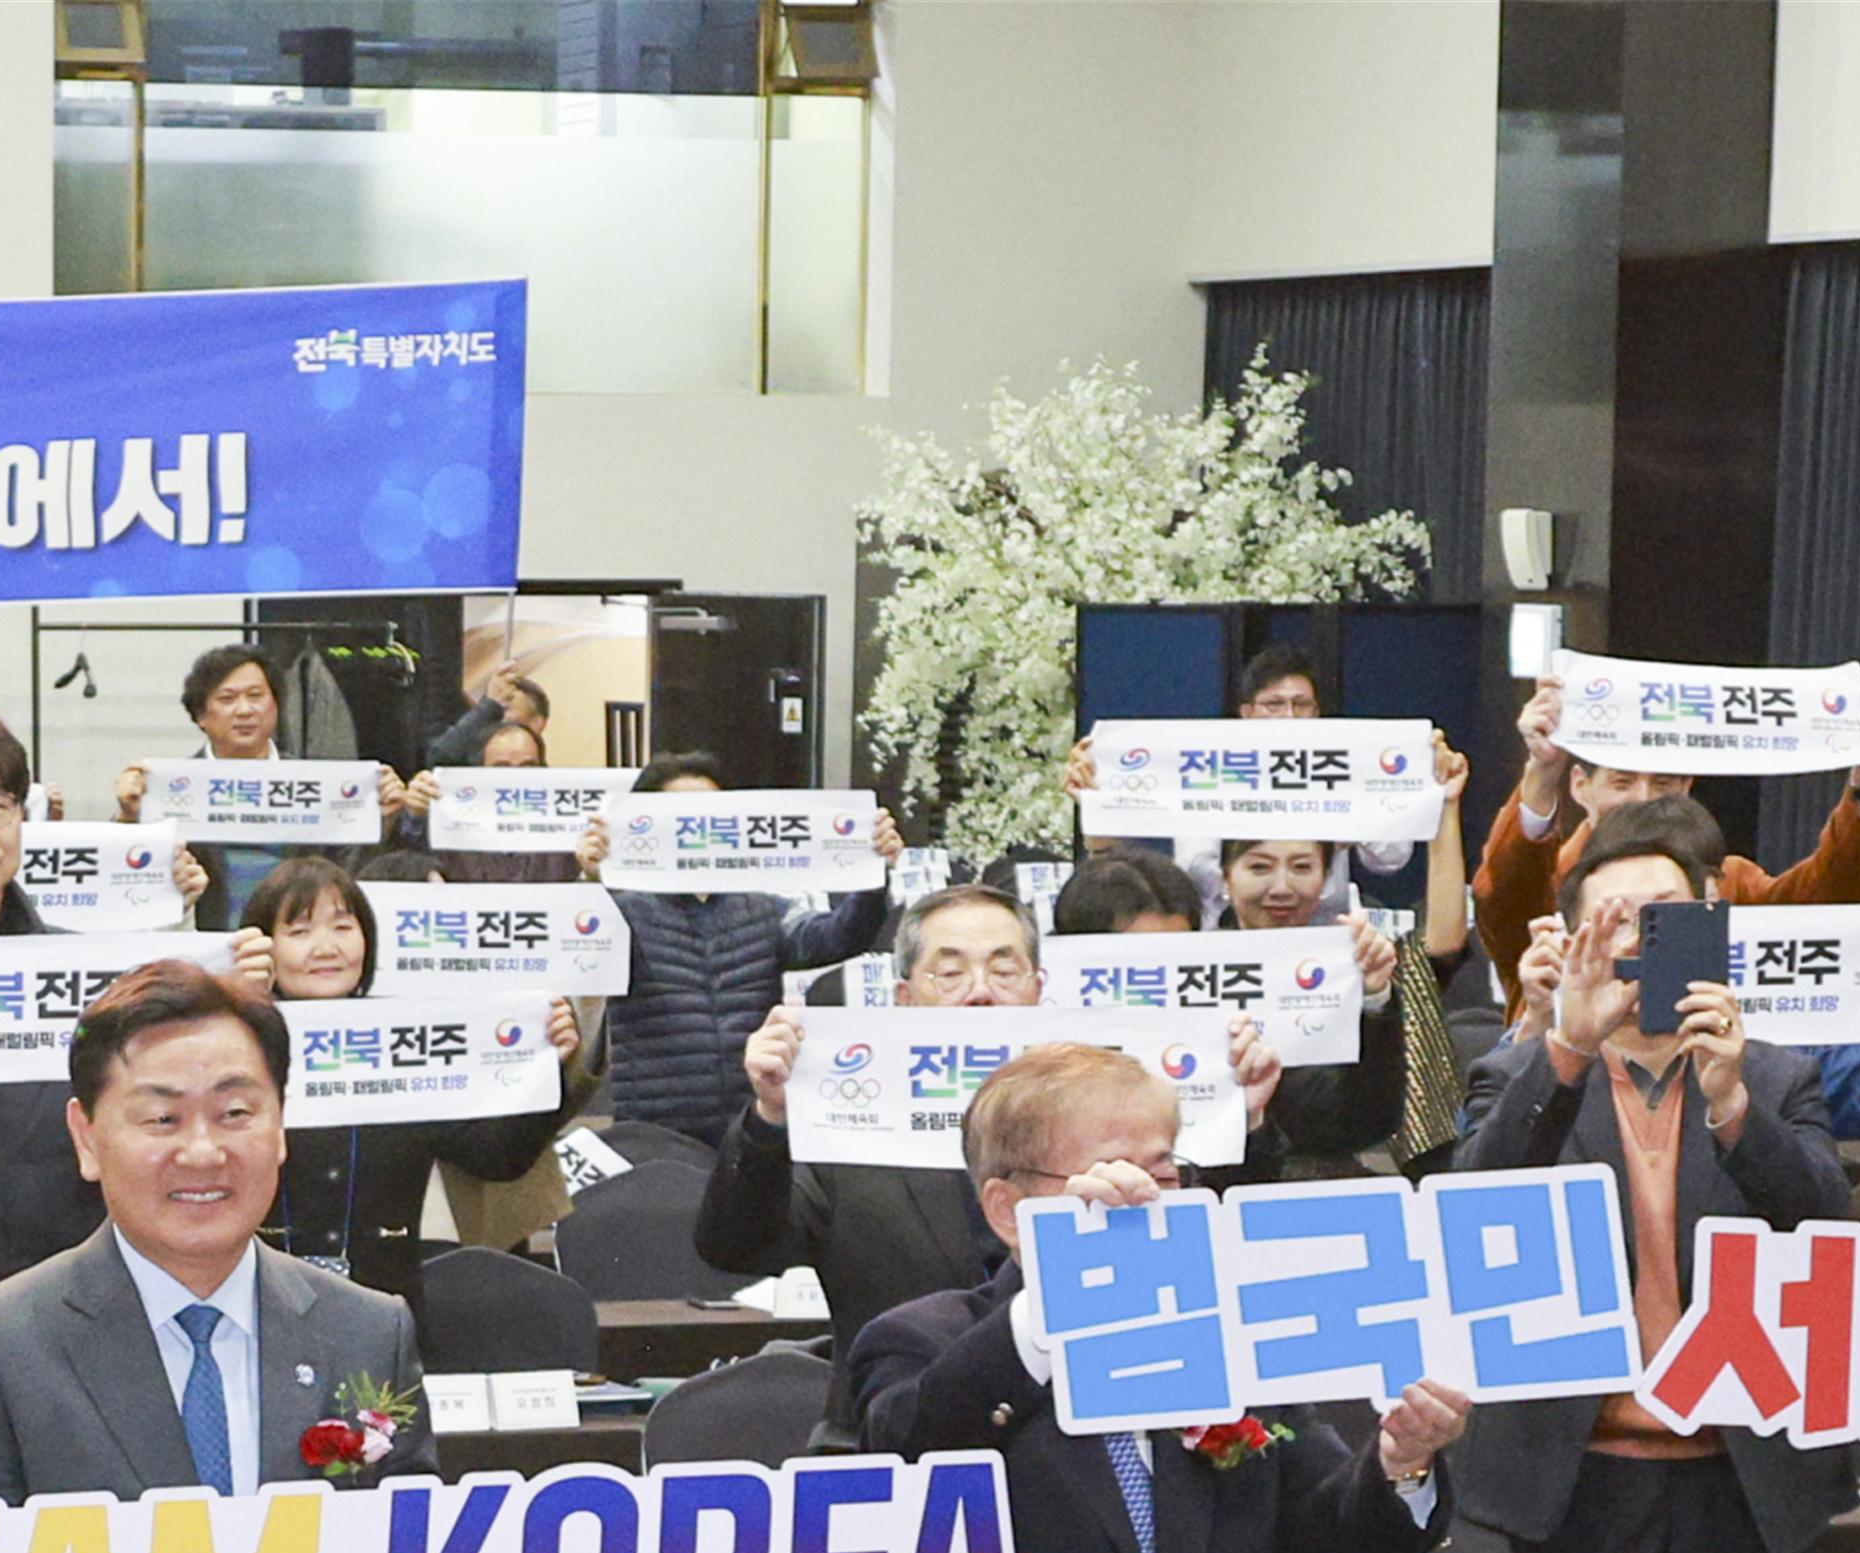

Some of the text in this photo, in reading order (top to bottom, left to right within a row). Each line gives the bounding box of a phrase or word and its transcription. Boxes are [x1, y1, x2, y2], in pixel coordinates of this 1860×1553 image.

[294, 330, 494, 371] 전북특별자치도
[1640, 683, 1797, 726] 전북 전주
[1179, 750, 1350, 790] 전북 전주
[208, 779, 321, 808] 전북 전주
[495, 789, 547, 815] 전북
[676, 816, 811, 849] 전북 전주
[23, 848, 98, 884] 전주
[396, 911, 549, 949] 전북 전주
[1755, 940, 1840, 985] 전주
[1080, 963, 1264, 1010] 전북 전주
[1776, 996, 1805, 1012] 유치
[303, 1024, 467, 1071] 전북 전주
[411, 1077, 437, 1092] 유치
[1034, 1181, 1634, 1427] 범국민
